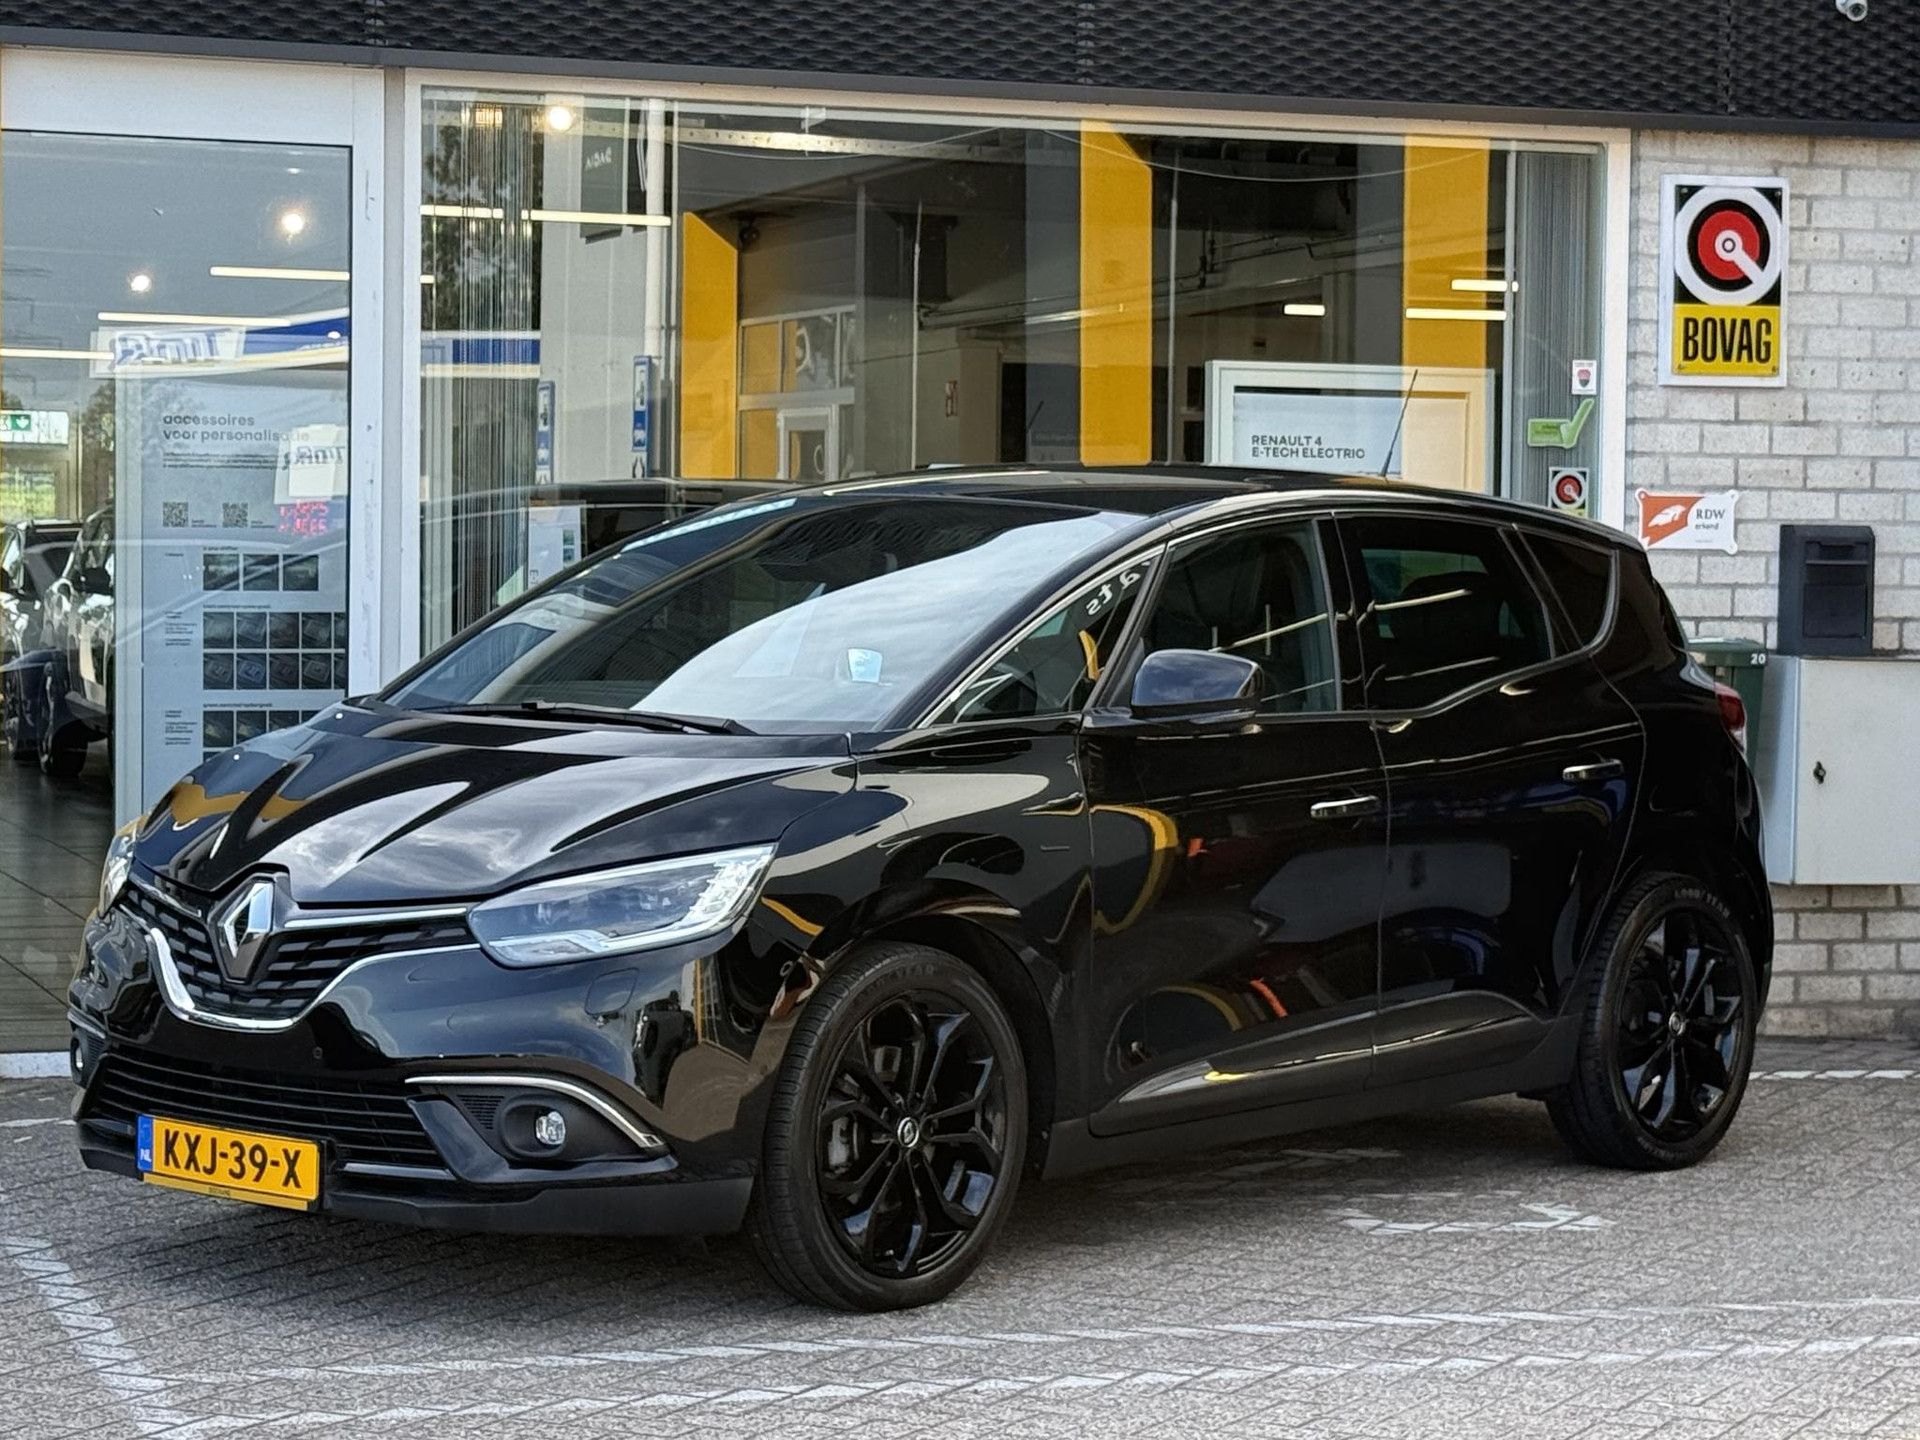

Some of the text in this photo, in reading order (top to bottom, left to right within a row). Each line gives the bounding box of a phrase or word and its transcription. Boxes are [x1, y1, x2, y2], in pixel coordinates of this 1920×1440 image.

[1682, 316, 1772, 364] BOVAG
[163, 414, 255, 426] accessoires
[163, 430, 197, 440] voor
[1251, 434, 1322, 446] RENAULT 4
[1252, 447, 1299, 458] E-TECH
[1696, 509, 1725, 520] RDW
[1750, 653, 1767, 665] 20
[140, 1148, 152, 1163] NL
[164, 1128, 302, 1189] KXJ-39-X
